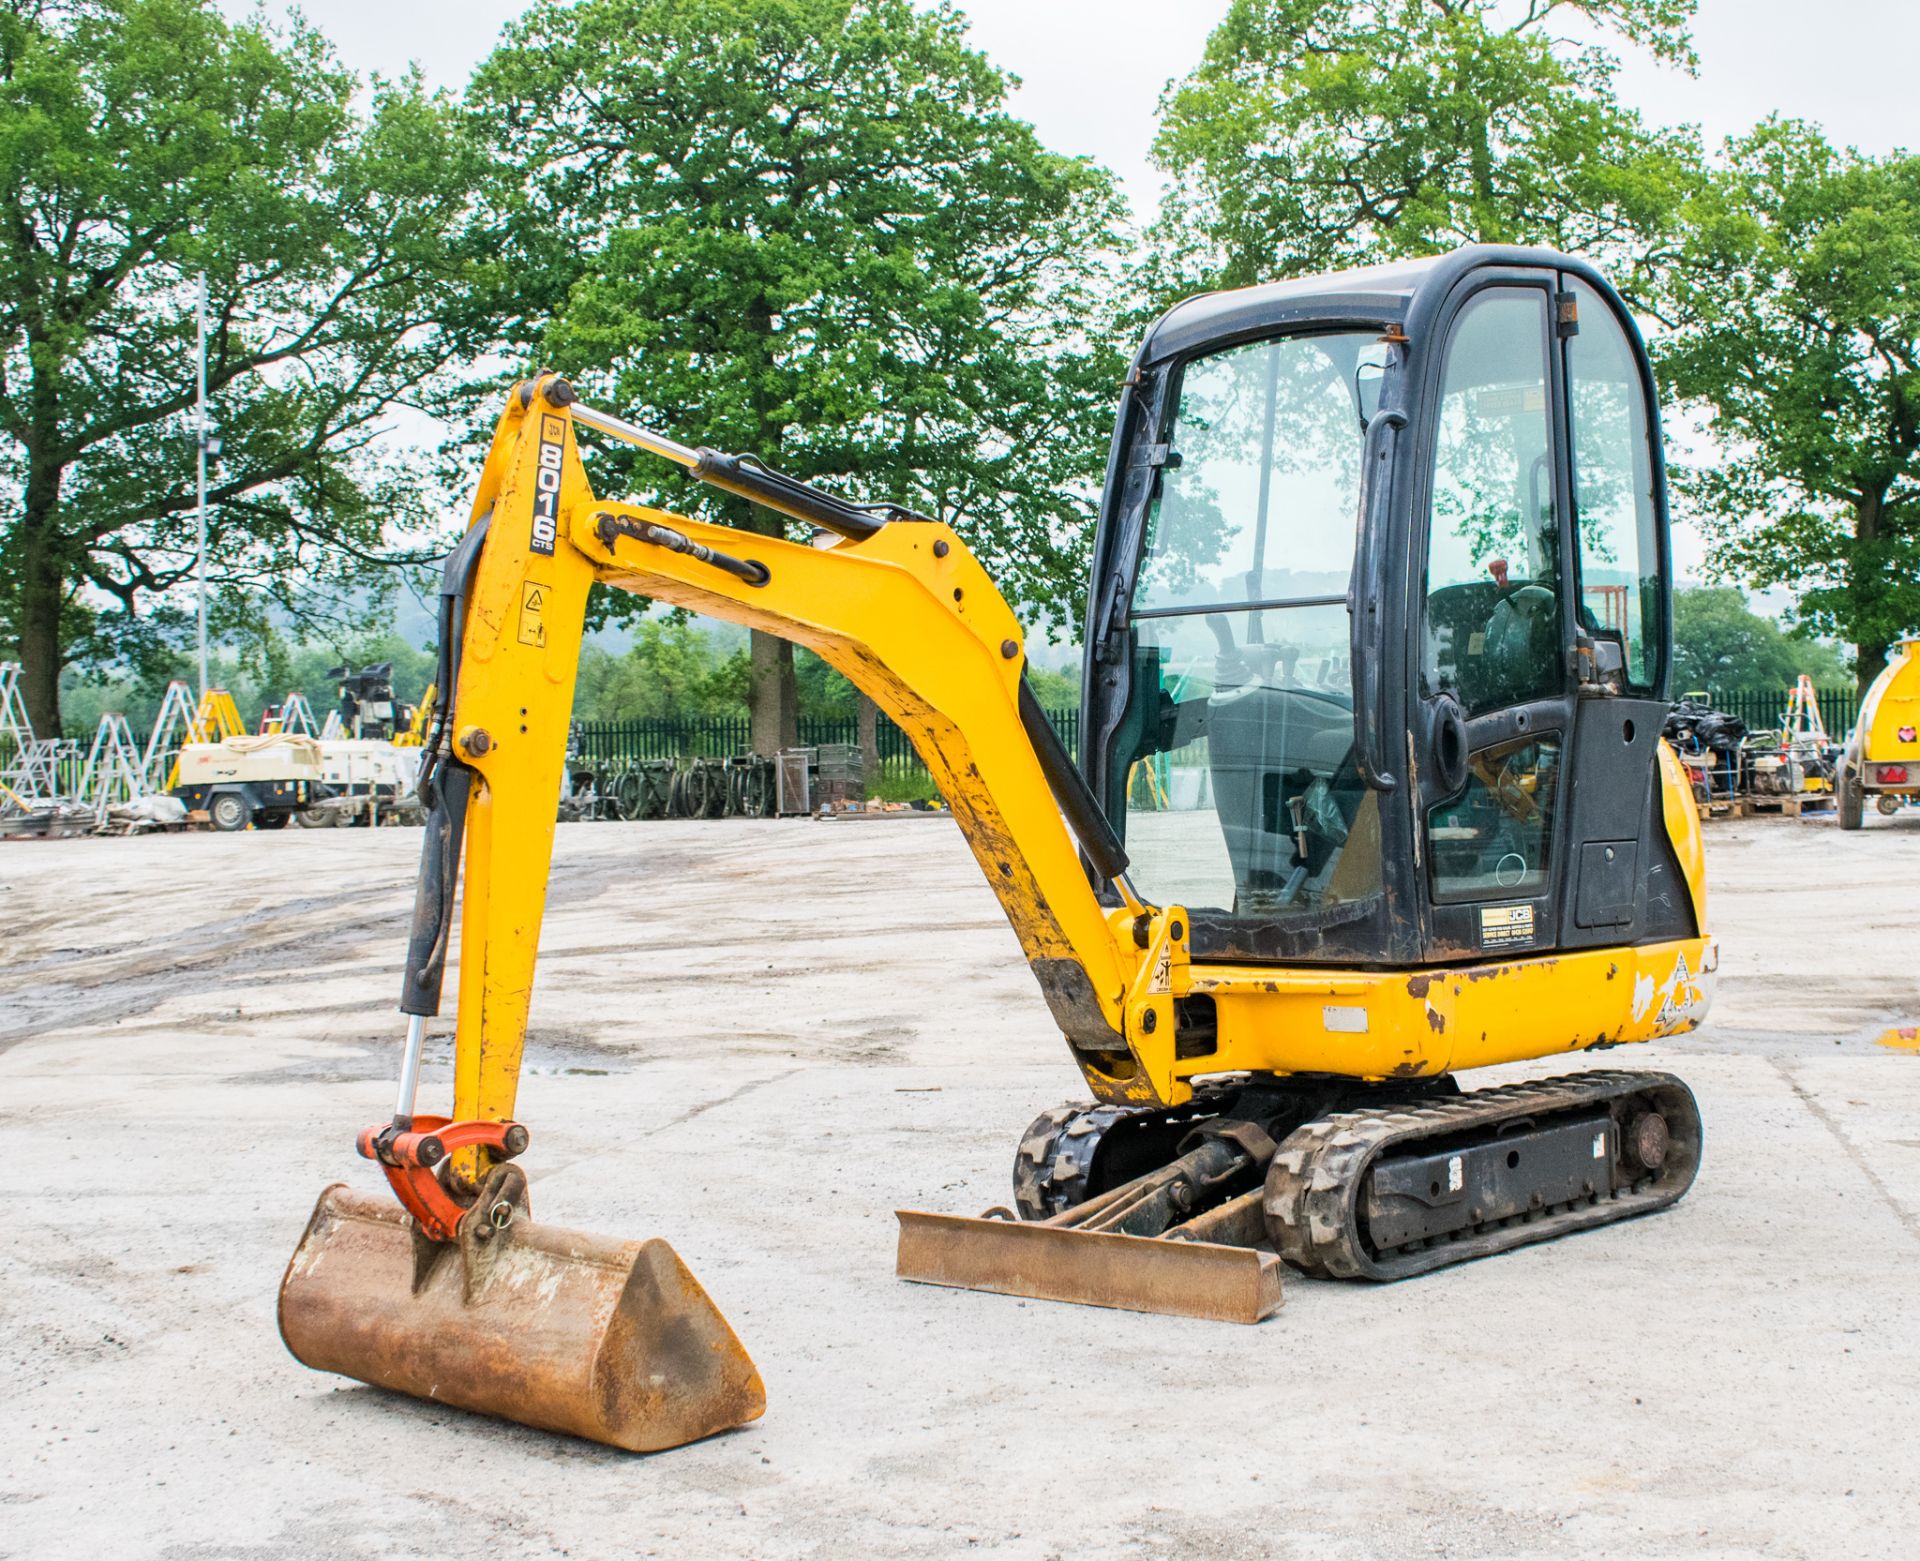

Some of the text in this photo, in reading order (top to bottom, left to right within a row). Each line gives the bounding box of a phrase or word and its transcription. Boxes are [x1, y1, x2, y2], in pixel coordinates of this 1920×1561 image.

[533, 444, 562, 542] 8016
[532, 538, 553, 551] CTS
[1509, 908, 1530, 921] JCB
